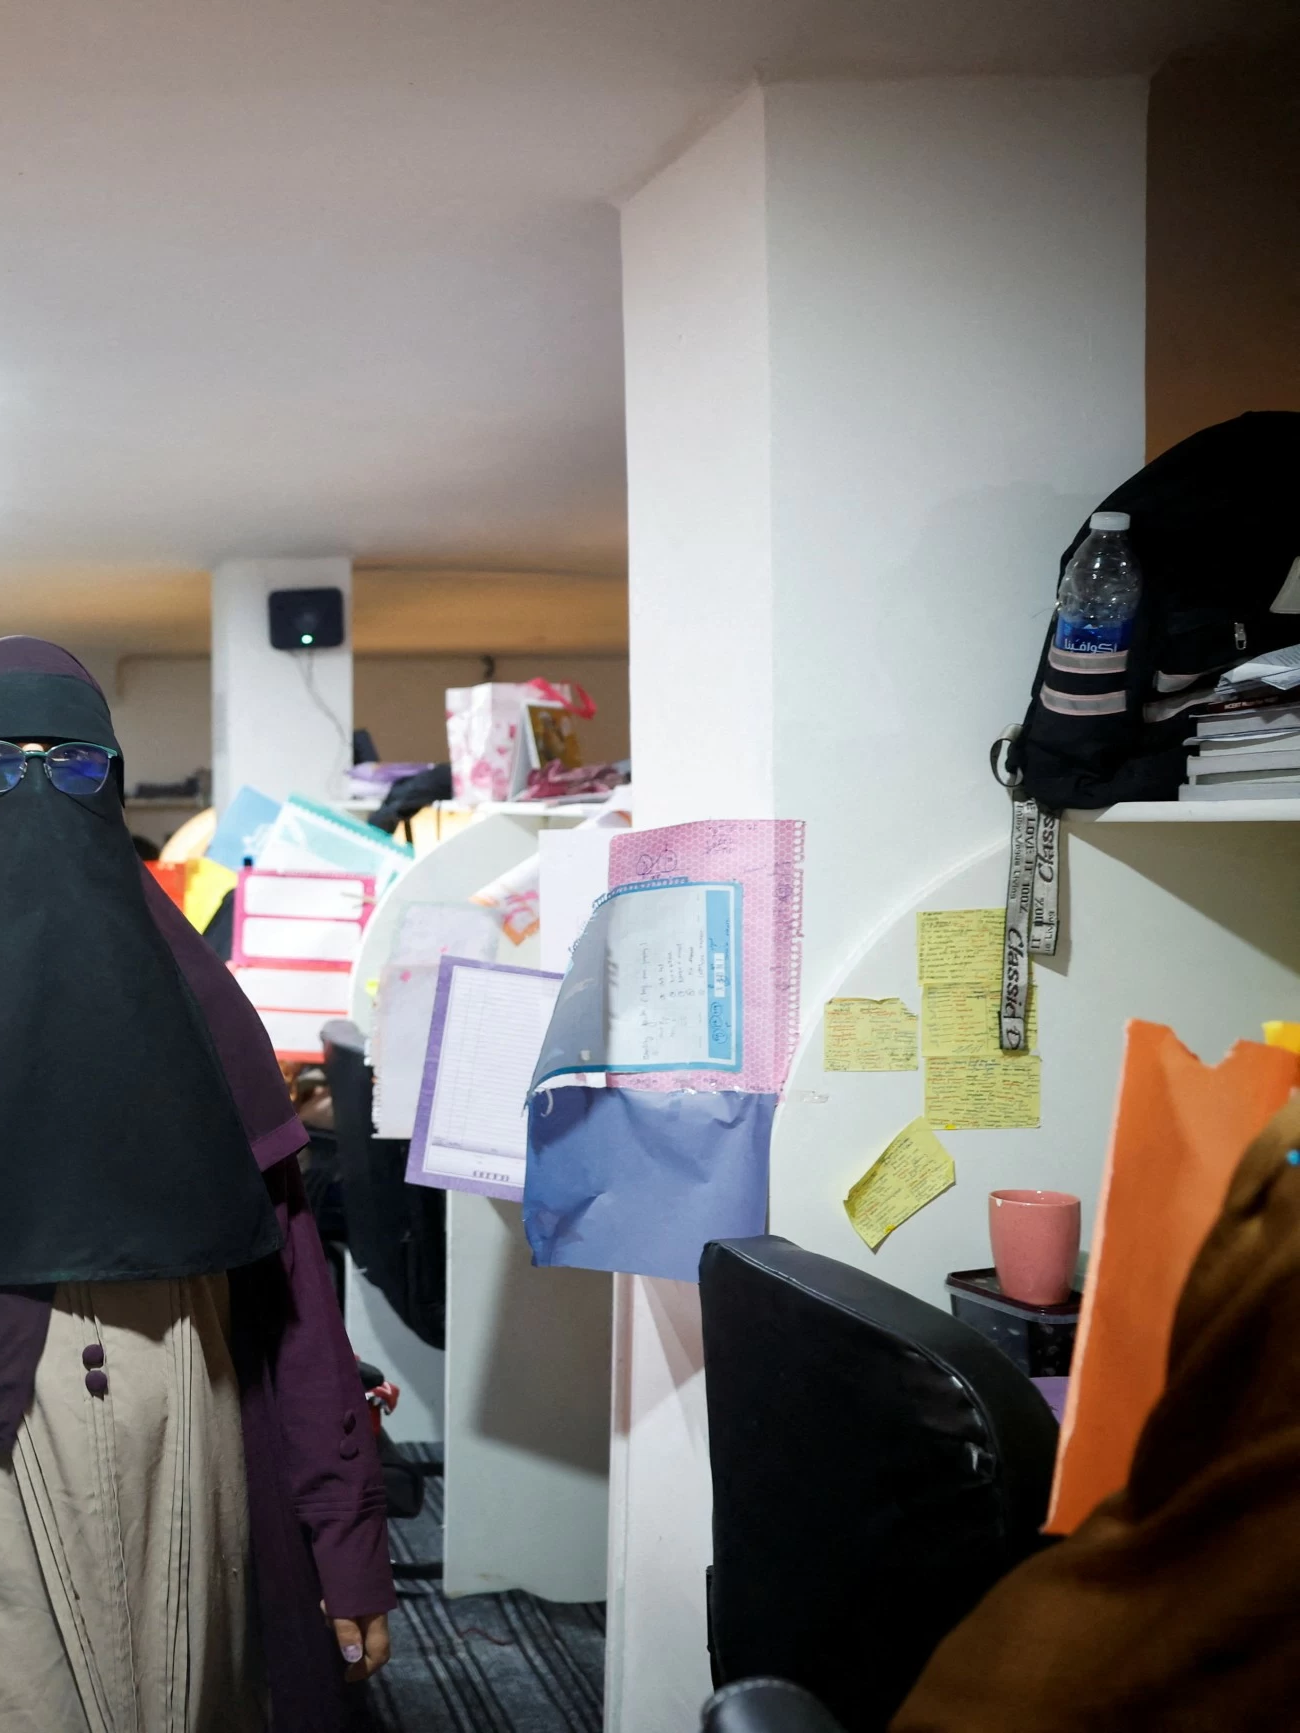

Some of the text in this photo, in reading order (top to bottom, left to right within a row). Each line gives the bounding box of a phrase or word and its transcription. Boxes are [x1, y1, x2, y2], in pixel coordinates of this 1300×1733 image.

[1025, 818, 1037, 855] LOVE
[1024, 860, 1034, 873] IT
[1020, 882, 1031, 914] 100%
[1045, 911, 1055, 941] Livng
[1005, 927, 1024, 1017] Classic
